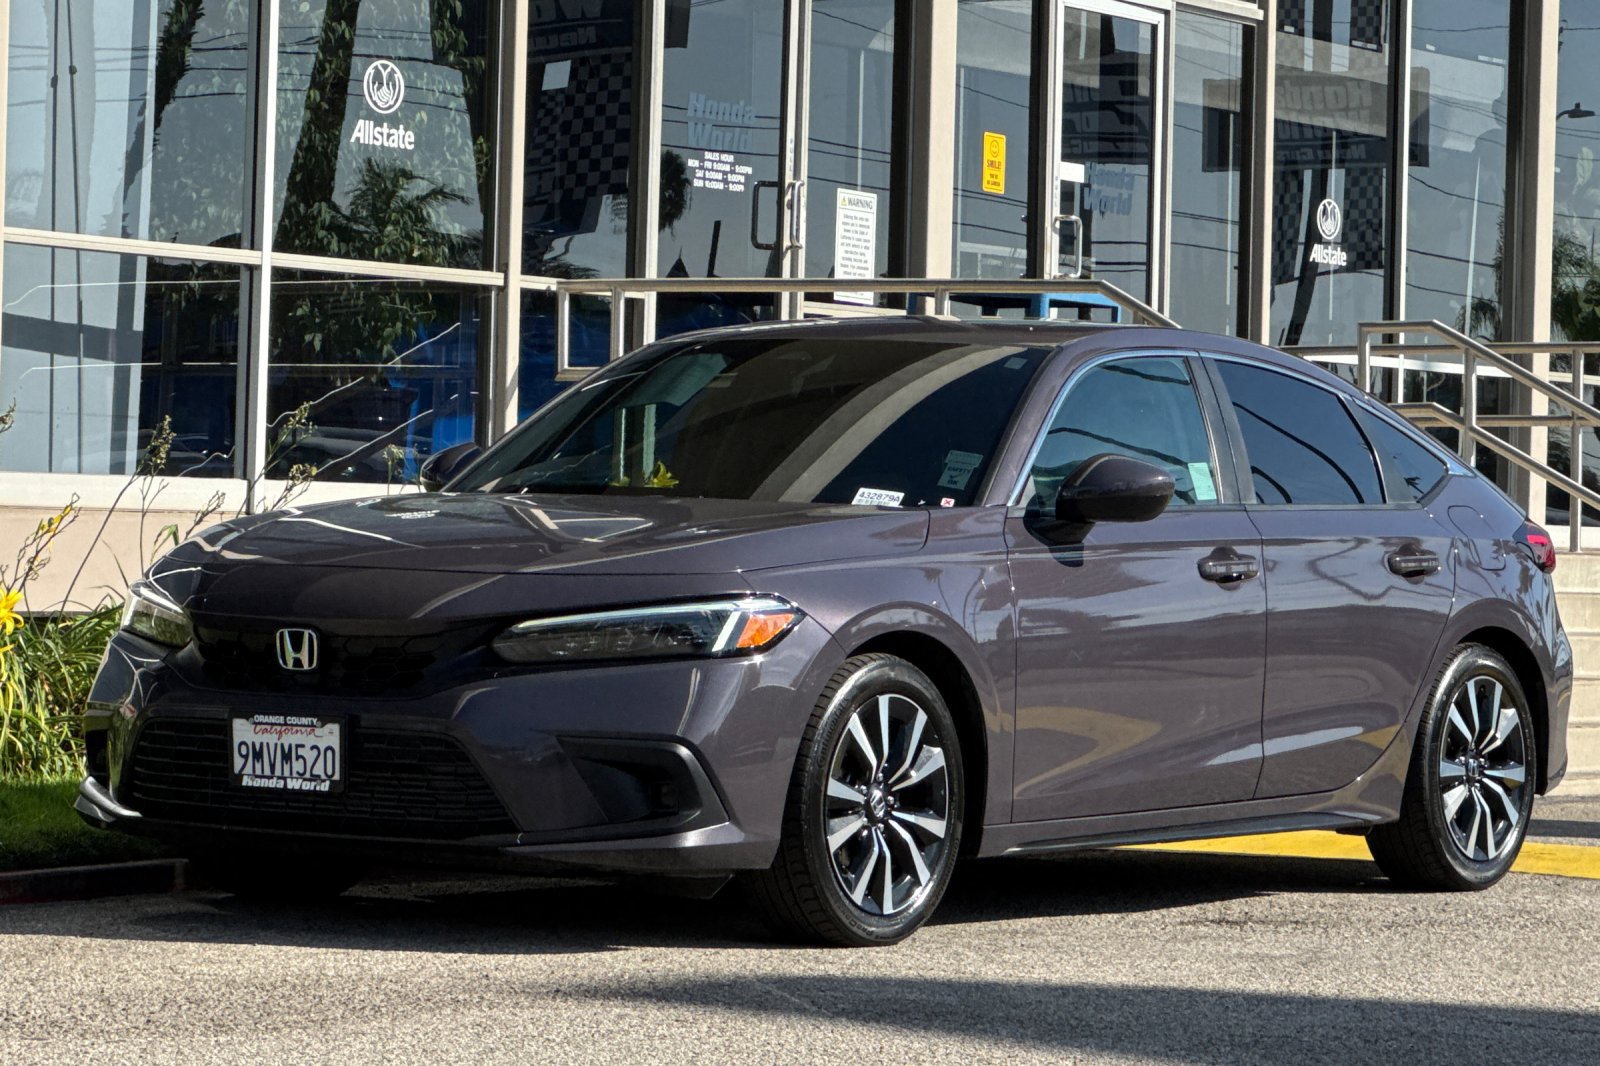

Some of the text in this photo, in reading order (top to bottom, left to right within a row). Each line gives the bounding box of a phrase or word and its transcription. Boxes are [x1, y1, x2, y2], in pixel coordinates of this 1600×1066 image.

[687, 91, 753, 124] Honda
[350, 119, 415, 150] Allstate
[687, 121, 753, 152] World
[704, 151, 720, 161] SALES
[687, 158, 699, 167] MON
[704, 161, 712, 169] FRI
[695, 169, 704, 178] SAT
[693, 178, 704, 187] SUN
[847, 196, 873, 210] WARNING
[1309, 243, 1347, 267] Allstate
[858, 491, 900, 503] 432879A
[253, 714, 318, 726] ORANGE COUNTY
[253, 724, 323, 741] California
[237, 740, 336, 779] 9MVM520
[241, 775, 285, 789] Honda
